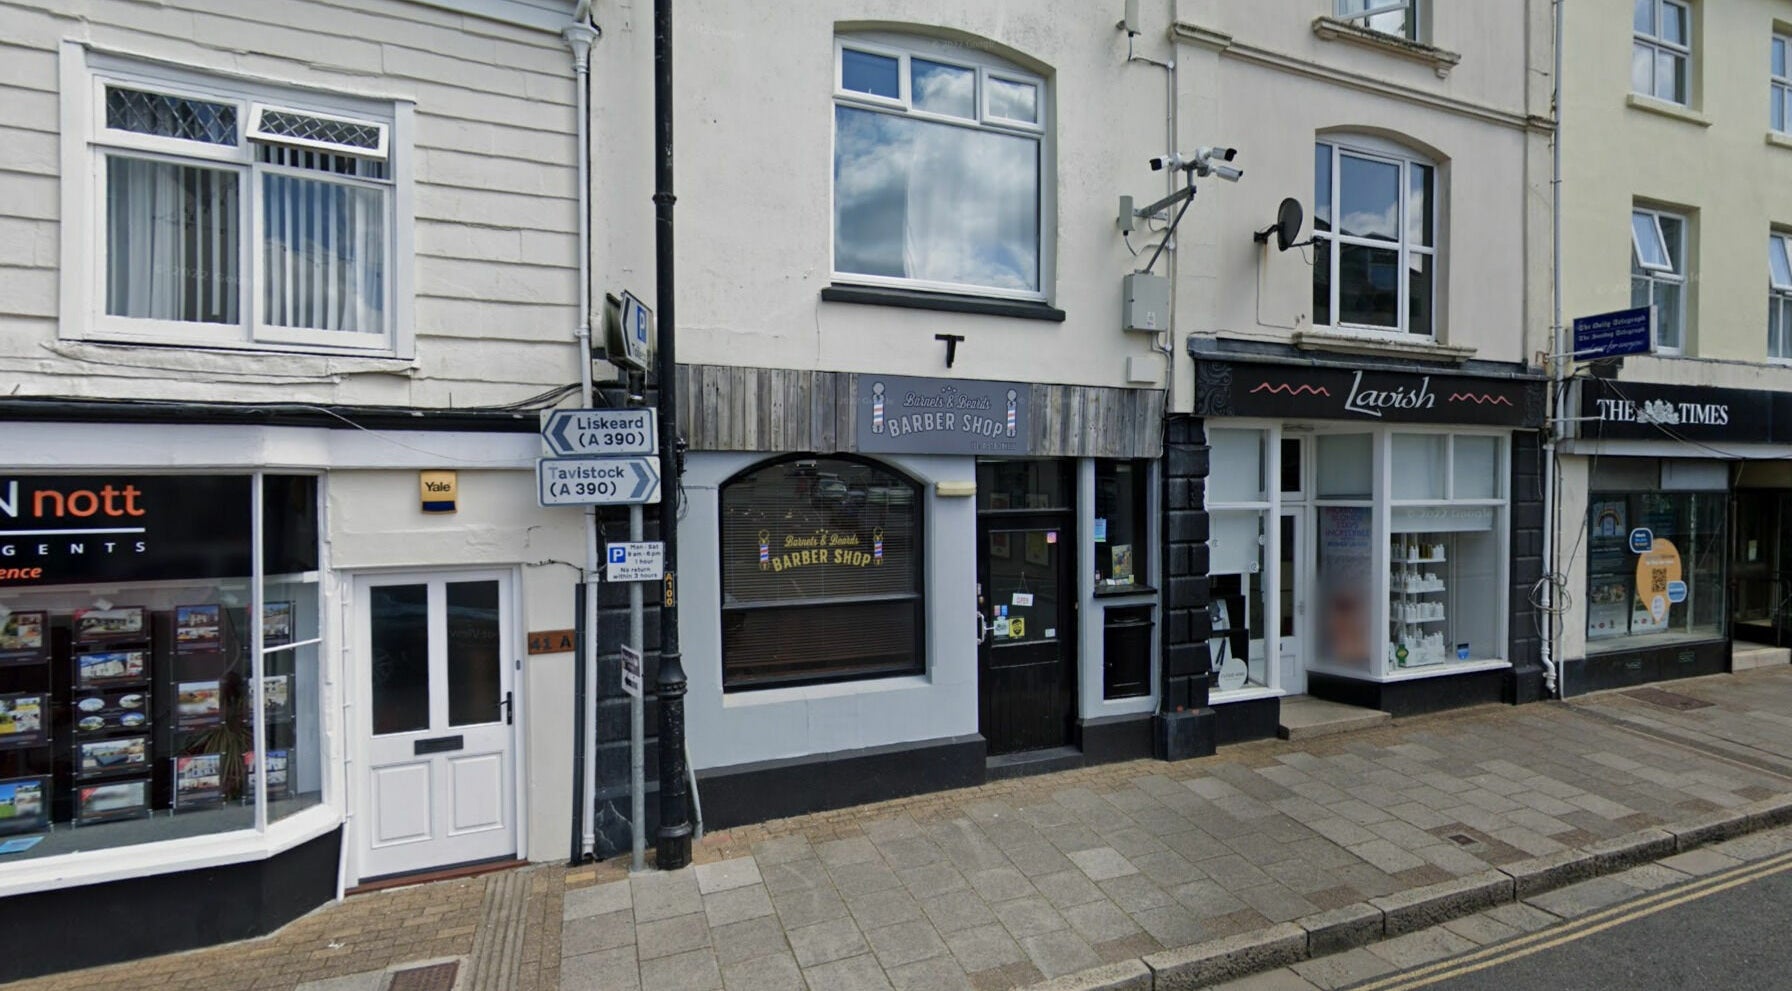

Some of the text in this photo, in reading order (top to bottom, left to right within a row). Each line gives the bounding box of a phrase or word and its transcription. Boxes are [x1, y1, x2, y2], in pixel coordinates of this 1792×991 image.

[1344, 370, 1435, 417] Lavish
[946, 394, 953, 408] &
[957, 394, 991, 410] Beards
[1597, 399, 1728, 425] THE TIMES
[577, 416, 644, 430] Liskeard
[888, 412, 1003, 438] BARBER SHOP
[548, 466, 625, 480] Tavistock
[425, 482, 450, 492] Yale
[34, 485, 145, 517] nott
[820, 534, 827, 546] &
[829, 533, 859, 546] Beards
[772, 548, 871, 572] BARBER SHOP
[560, 636, 571, 648] A
